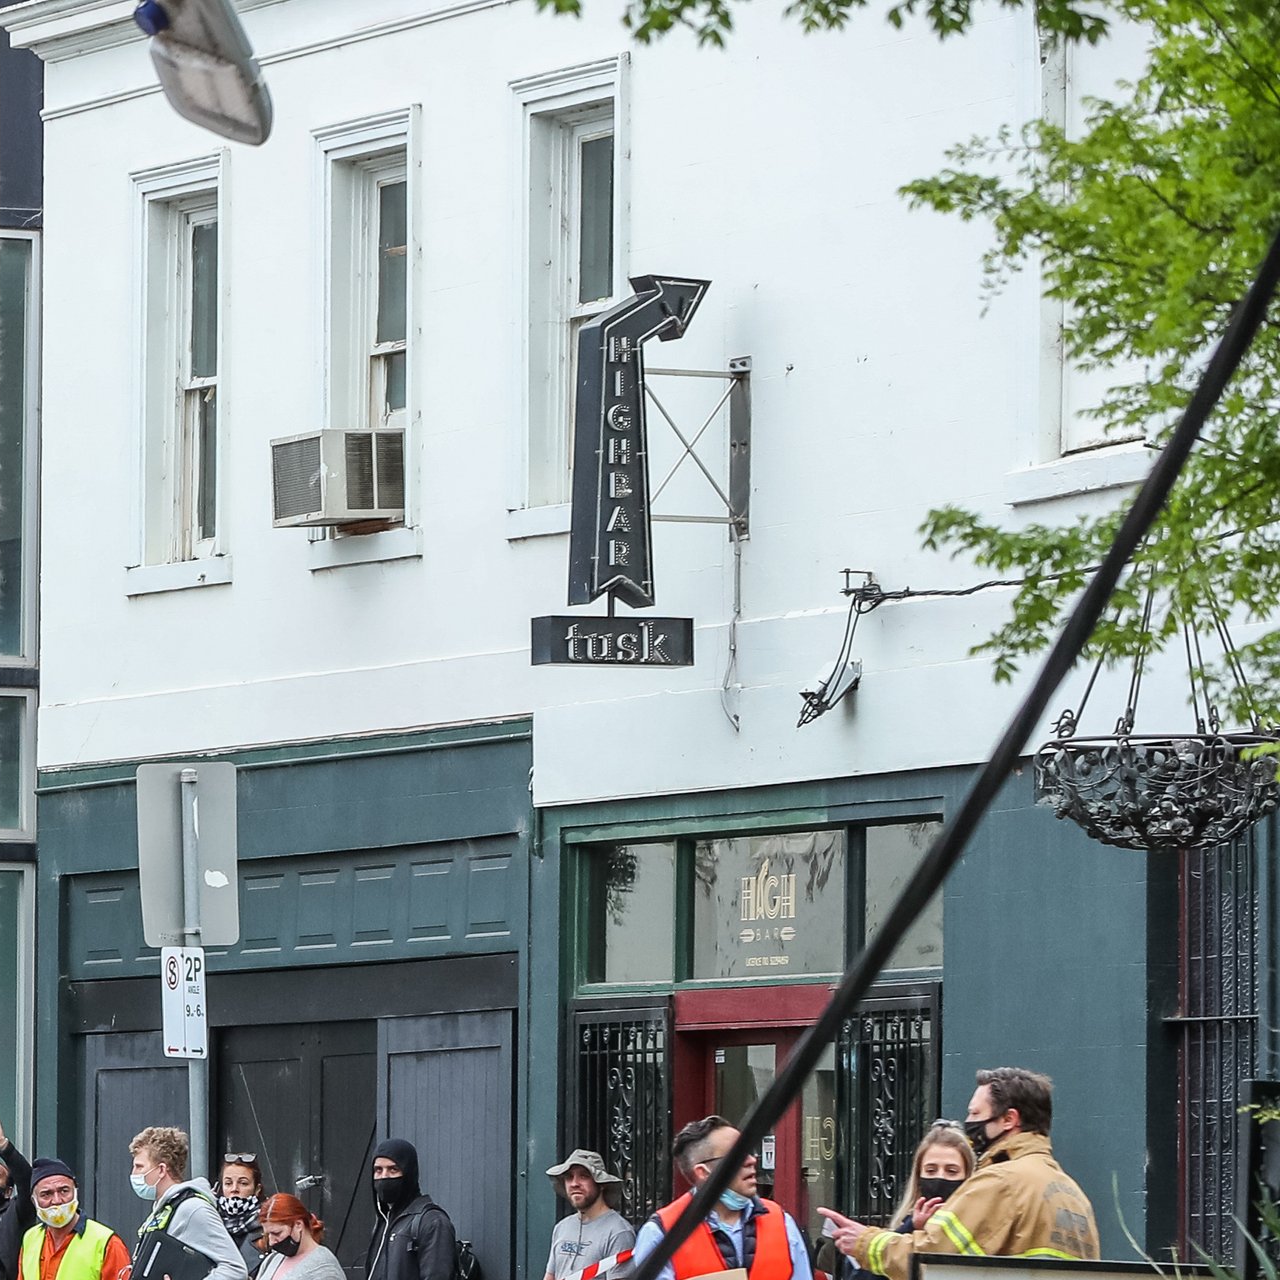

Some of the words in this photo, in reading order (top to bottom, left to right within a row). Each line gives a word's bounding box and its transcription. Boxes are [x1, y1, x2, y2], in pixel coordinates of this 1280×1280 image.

[565, 621, 671, 662] tusk
[741, 859, 796, 920] HIGH
[755, 927, 780, 942] BAR
[185, 957, 201, 982] 2P
